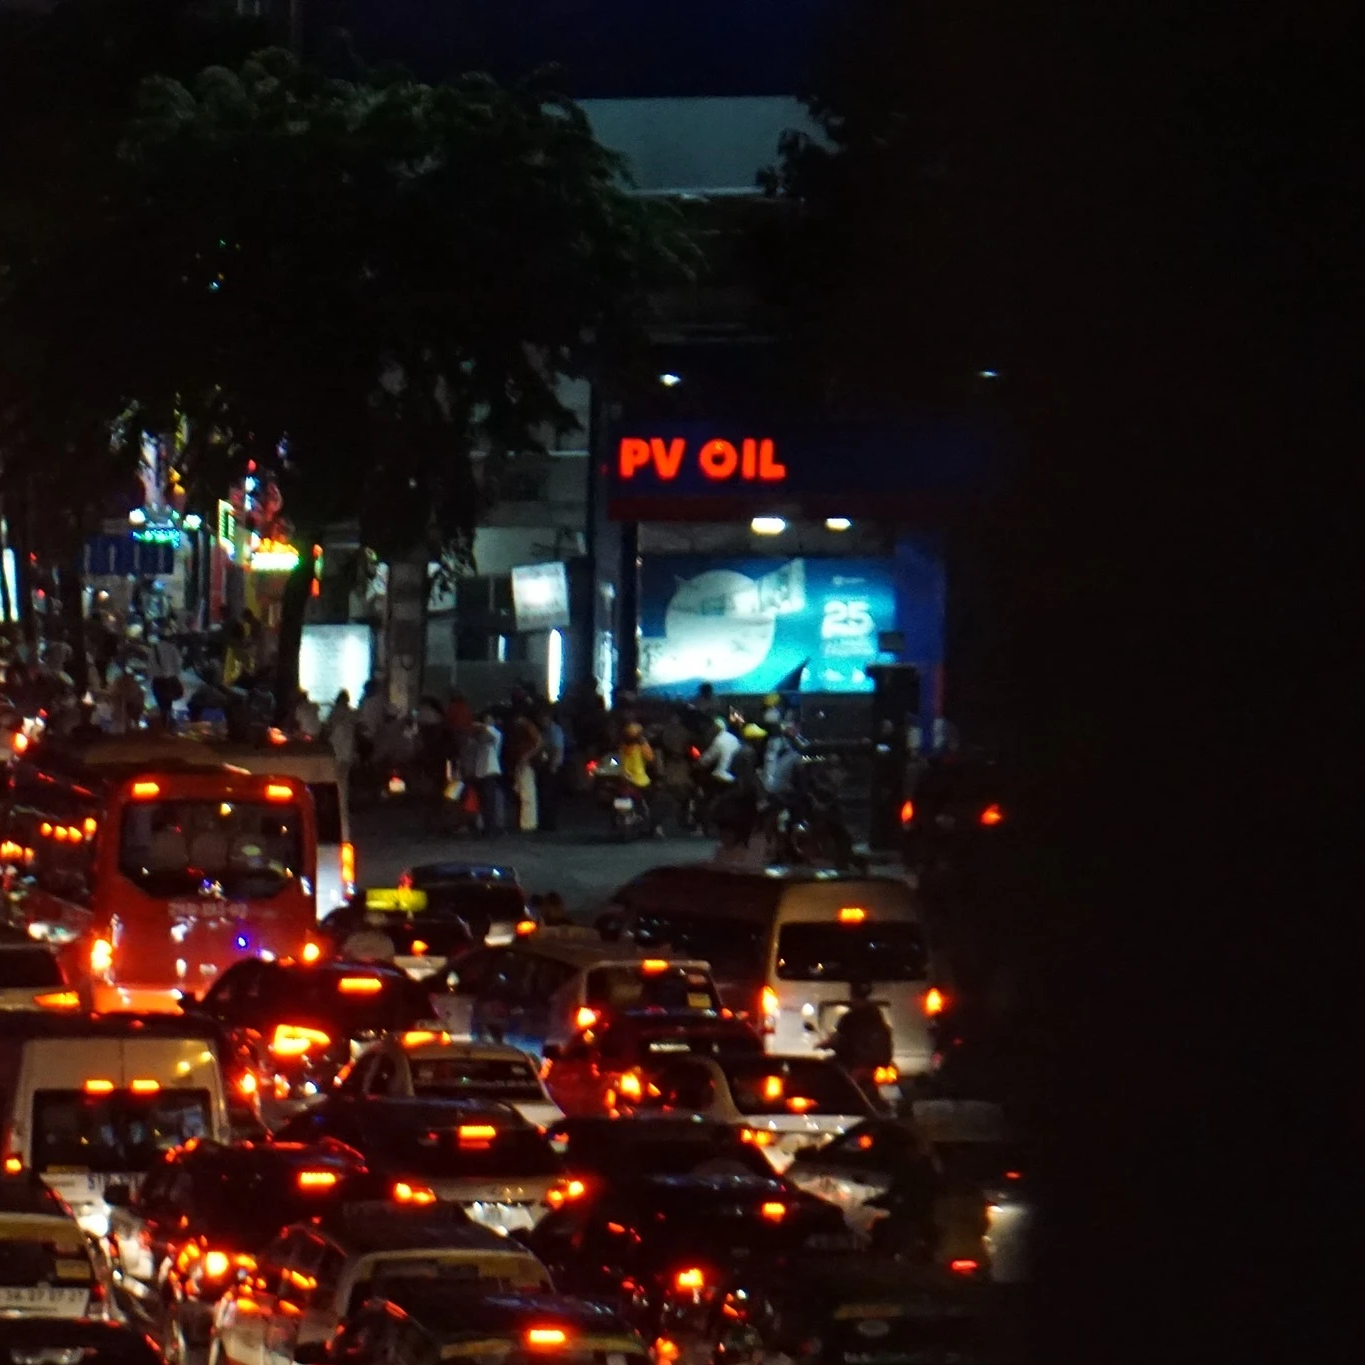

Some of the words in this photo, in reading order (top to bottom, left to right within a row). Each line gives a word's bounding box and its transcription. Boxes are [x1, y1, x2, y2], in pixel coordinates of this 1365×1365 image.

[619, 438, 686, 480] PV
[699, 438, 787, 481] OIL
[822, 600, 875, 638] 25
